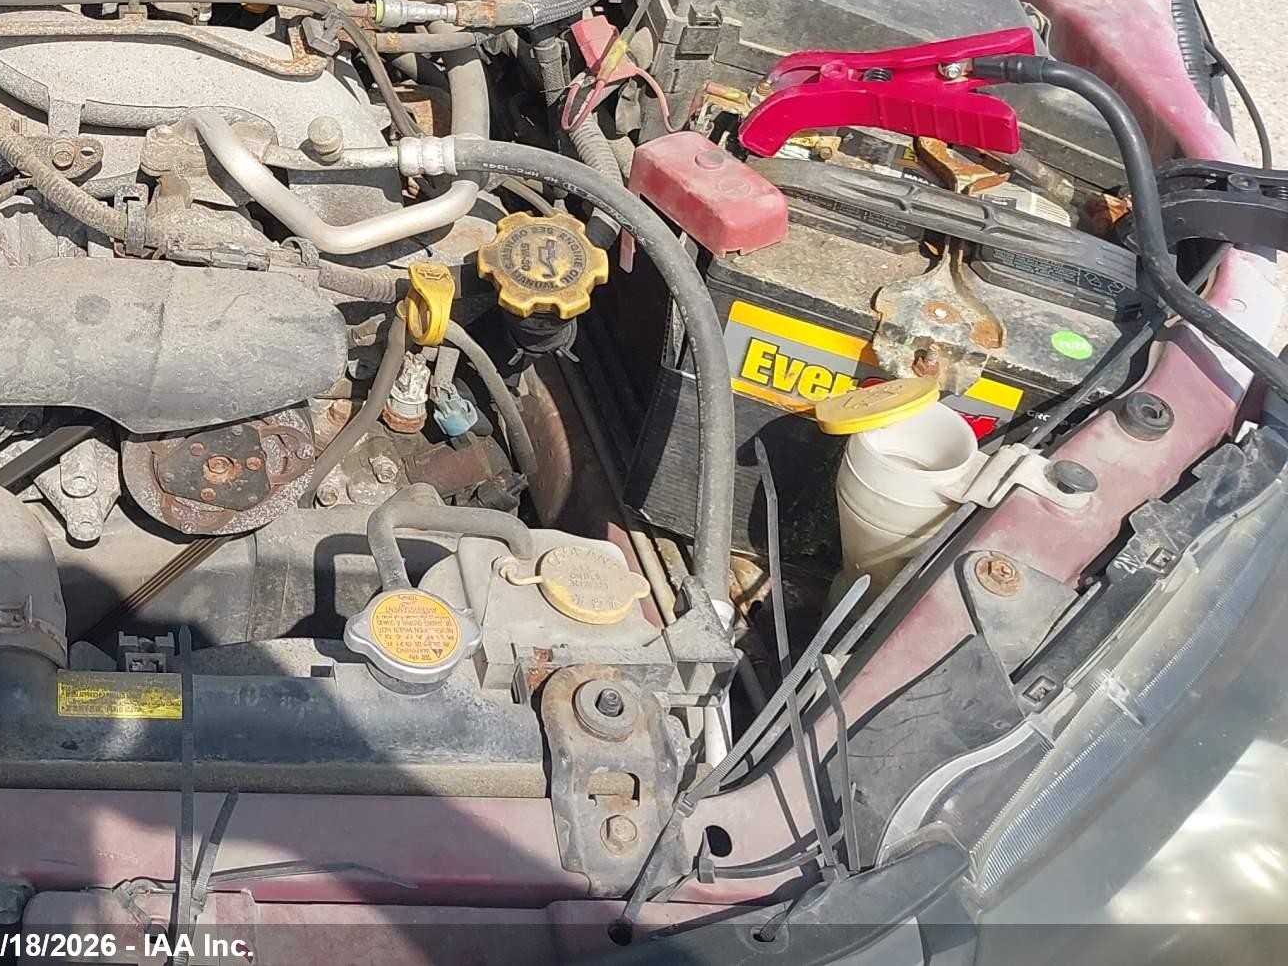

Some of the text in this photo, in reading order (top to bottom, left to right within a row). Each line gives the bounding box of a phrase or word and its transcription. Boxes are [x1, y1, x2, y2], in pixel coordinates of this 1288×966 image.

[520, 242, 531, 272] 5W-30
[558, 232, 583, 285] ENGINE OIL
